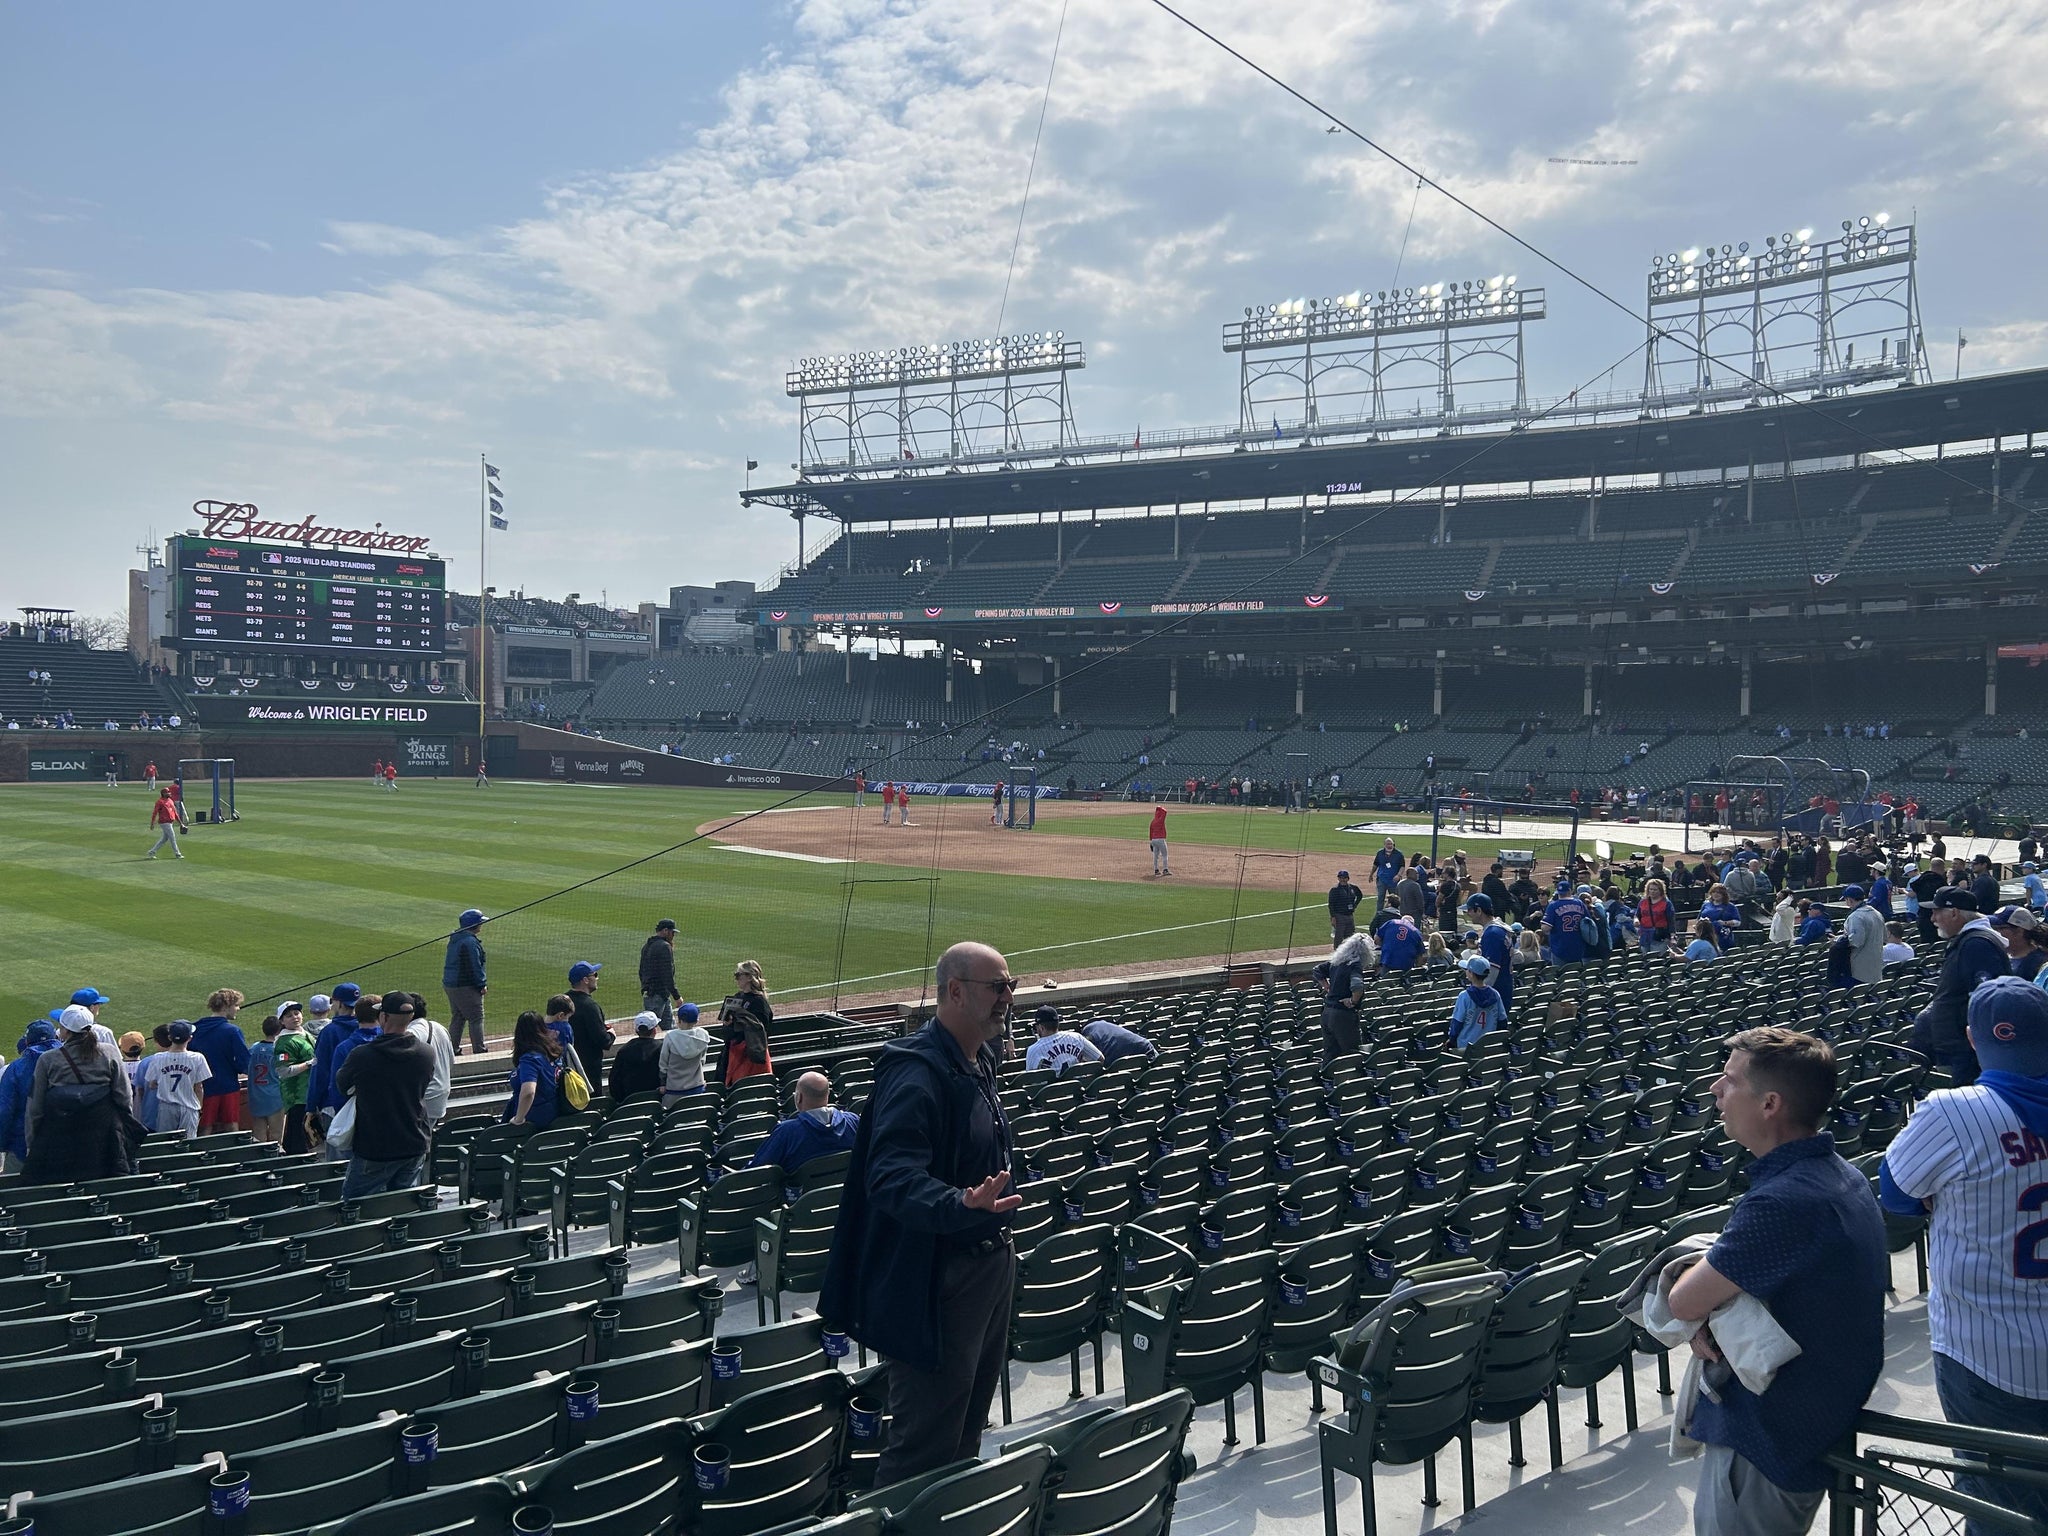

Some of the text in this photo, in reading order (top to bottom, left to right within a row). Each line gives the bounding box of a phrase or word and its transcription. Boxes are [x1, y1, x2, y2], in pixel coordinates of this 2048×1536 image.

[1326, 482, 1362, 493] 11:29 AM
[193, 500, 431, 551] Budweiser
[285, 556, 301, 564] 2025
[302, 558, 320, 566] WILD
[340, 561, 376, 570] STANDINGS
[195, 589, 219, 597] PADRES
[974, 607, 1075, 618] OPENING DAY 2026 AT WRIGLEY FIELD
[1151, 604, 1177, 613] OPENING
[1177, 603, 1191, 612] DAY
[1217, 602, 1246, 611] WRIGLEY
[1246, 601, 1264, 610] FIELD
[813, 613, 834, 621] OPENING
[834, 612, 845, 621] DAY
[859, 612, 867, 621] AT
[867, 612, 889, 620] WRIGLEY
[889, 611, 904, 620] FIELD
[445, 622, 459, 631] re
[248, 705, 428, 721] Welcome to WRIGLEY FIELD
[407, 744, 447, 754] DRAFT
[412, 752, 446, 761] KINGS
[30, 761, 86, 771] SLOAN
[620, 760, 645, 773] MARQUEE
[737, 775, 781, 784] Invesco QQQ
[914, 783, 938, 795] Wrap
[1562, 915, 1581, 932] 23
[1396, 926, 1408, 940] 3
[1476, 1011, 1487, 1029] 4
[1993, 1022, 2017, 1041] C
[161, 1060, 193, 1075] SWANSON
[254, 1064, 270, 1085] 2
[169, 1074, 183, 1093] 7
[2000, 1128, 2048, 1168] SA
[2013, 1182, 2048, 1280] 2
[1136, 1336, 1145, 1348] 13
[1322, 1368, 1334, 1381] 14
[1140, 1422, 1152, 1434] 21
